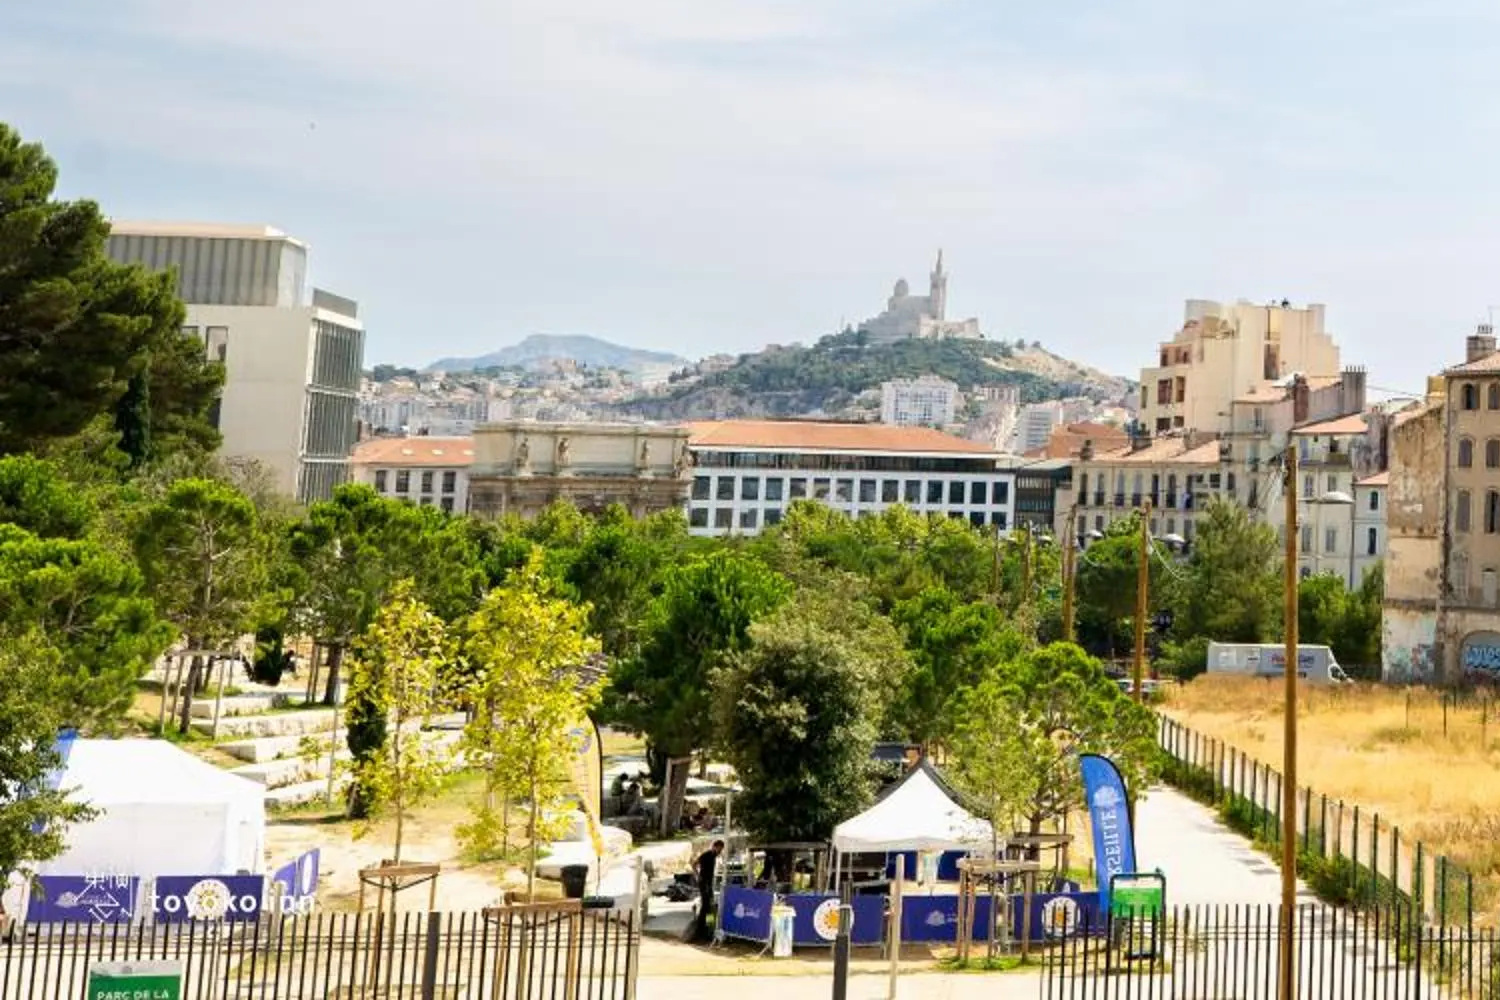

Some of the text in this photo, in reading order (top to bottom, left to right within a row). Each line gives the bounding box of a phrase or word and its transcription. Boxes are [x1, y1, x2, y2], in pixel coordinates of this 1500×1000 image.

[97, 988, 169, 1000] PARC DE LA
